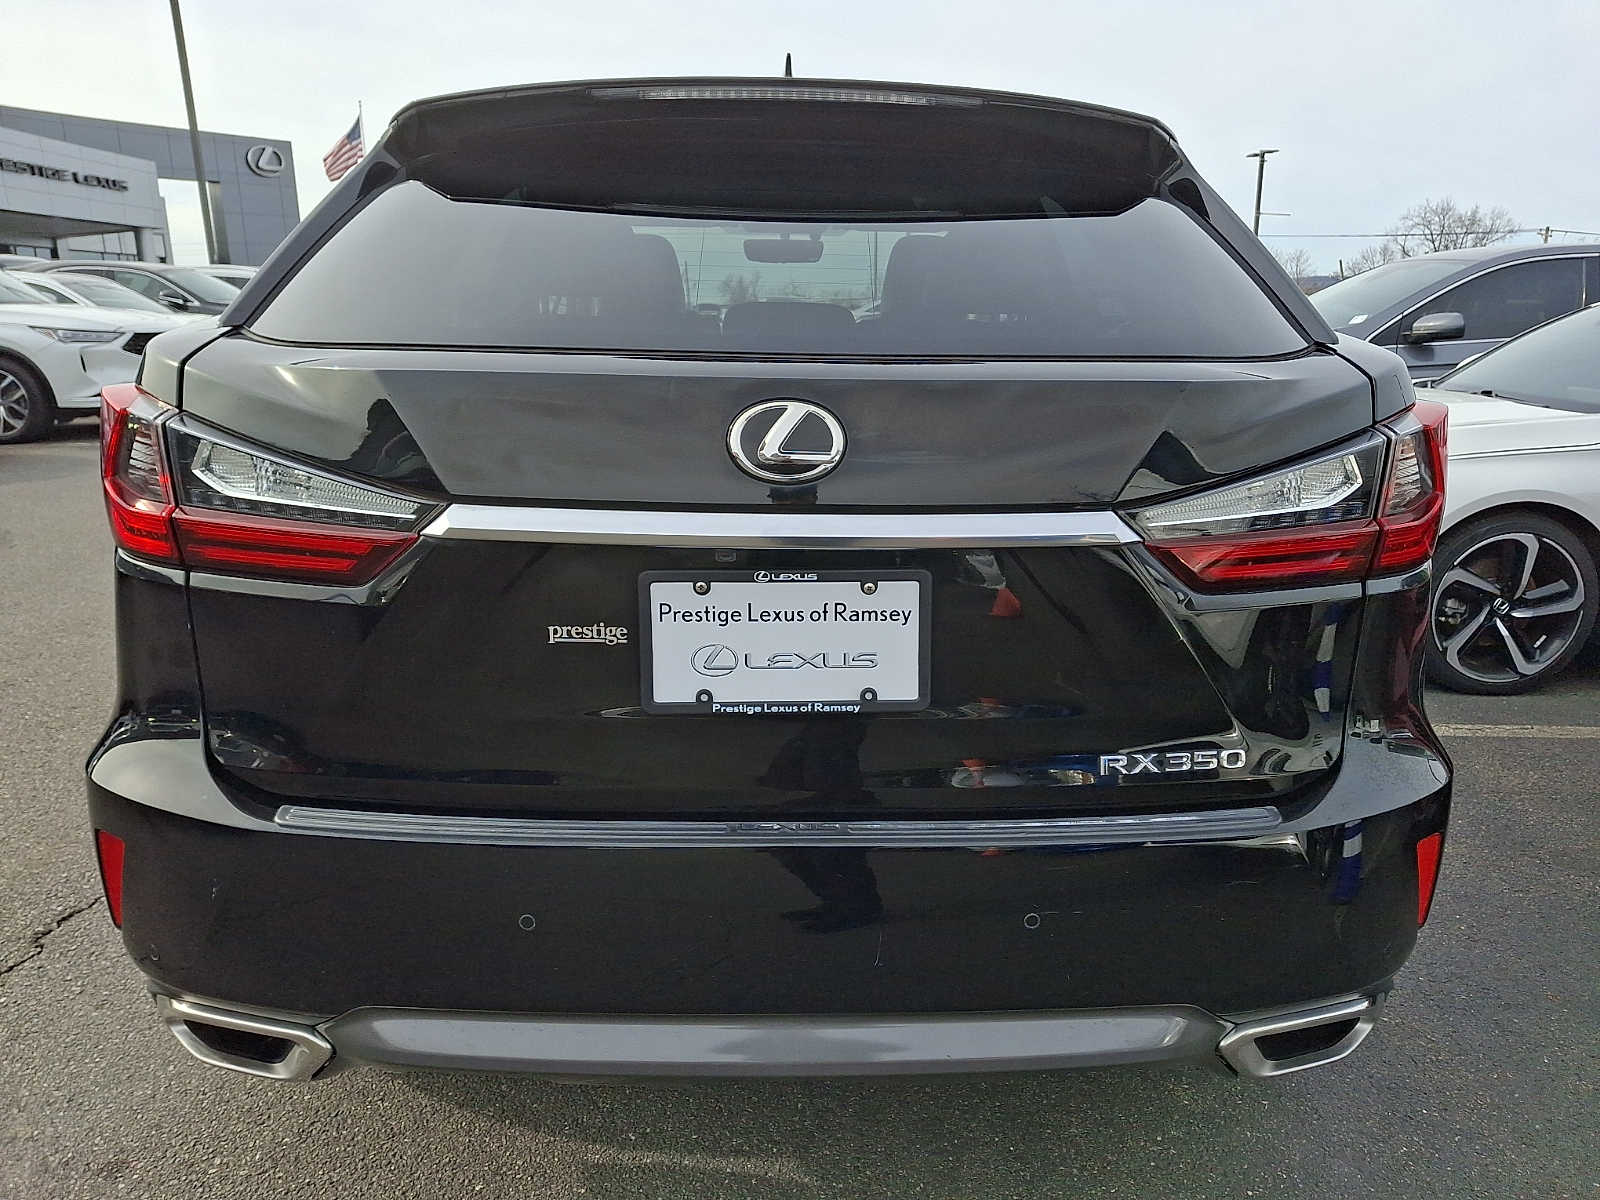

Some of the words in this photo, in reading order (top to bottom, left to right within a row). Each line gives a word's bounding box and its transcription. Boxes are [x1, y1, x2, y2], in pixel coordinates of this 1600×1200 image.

[71, 171, 129, 192] LEXUS
[771, 573, 818, 581] LEXUS
[659, 602, 742, 627] Prestige
[747, 602, 805, 622] Lexus
[809, 602, 829, 622] of
[834, 602, 912, 626] Ramsey
[547, 622, 628, 646] prestige
[744, 652, 879, 669] LEXUS
[712, 703, 762, 714] Prestige
[764, 703, 798, 712] Lexus
[799, 703, 813, 712] of
[814, 702, 861, 713] Ramsey
